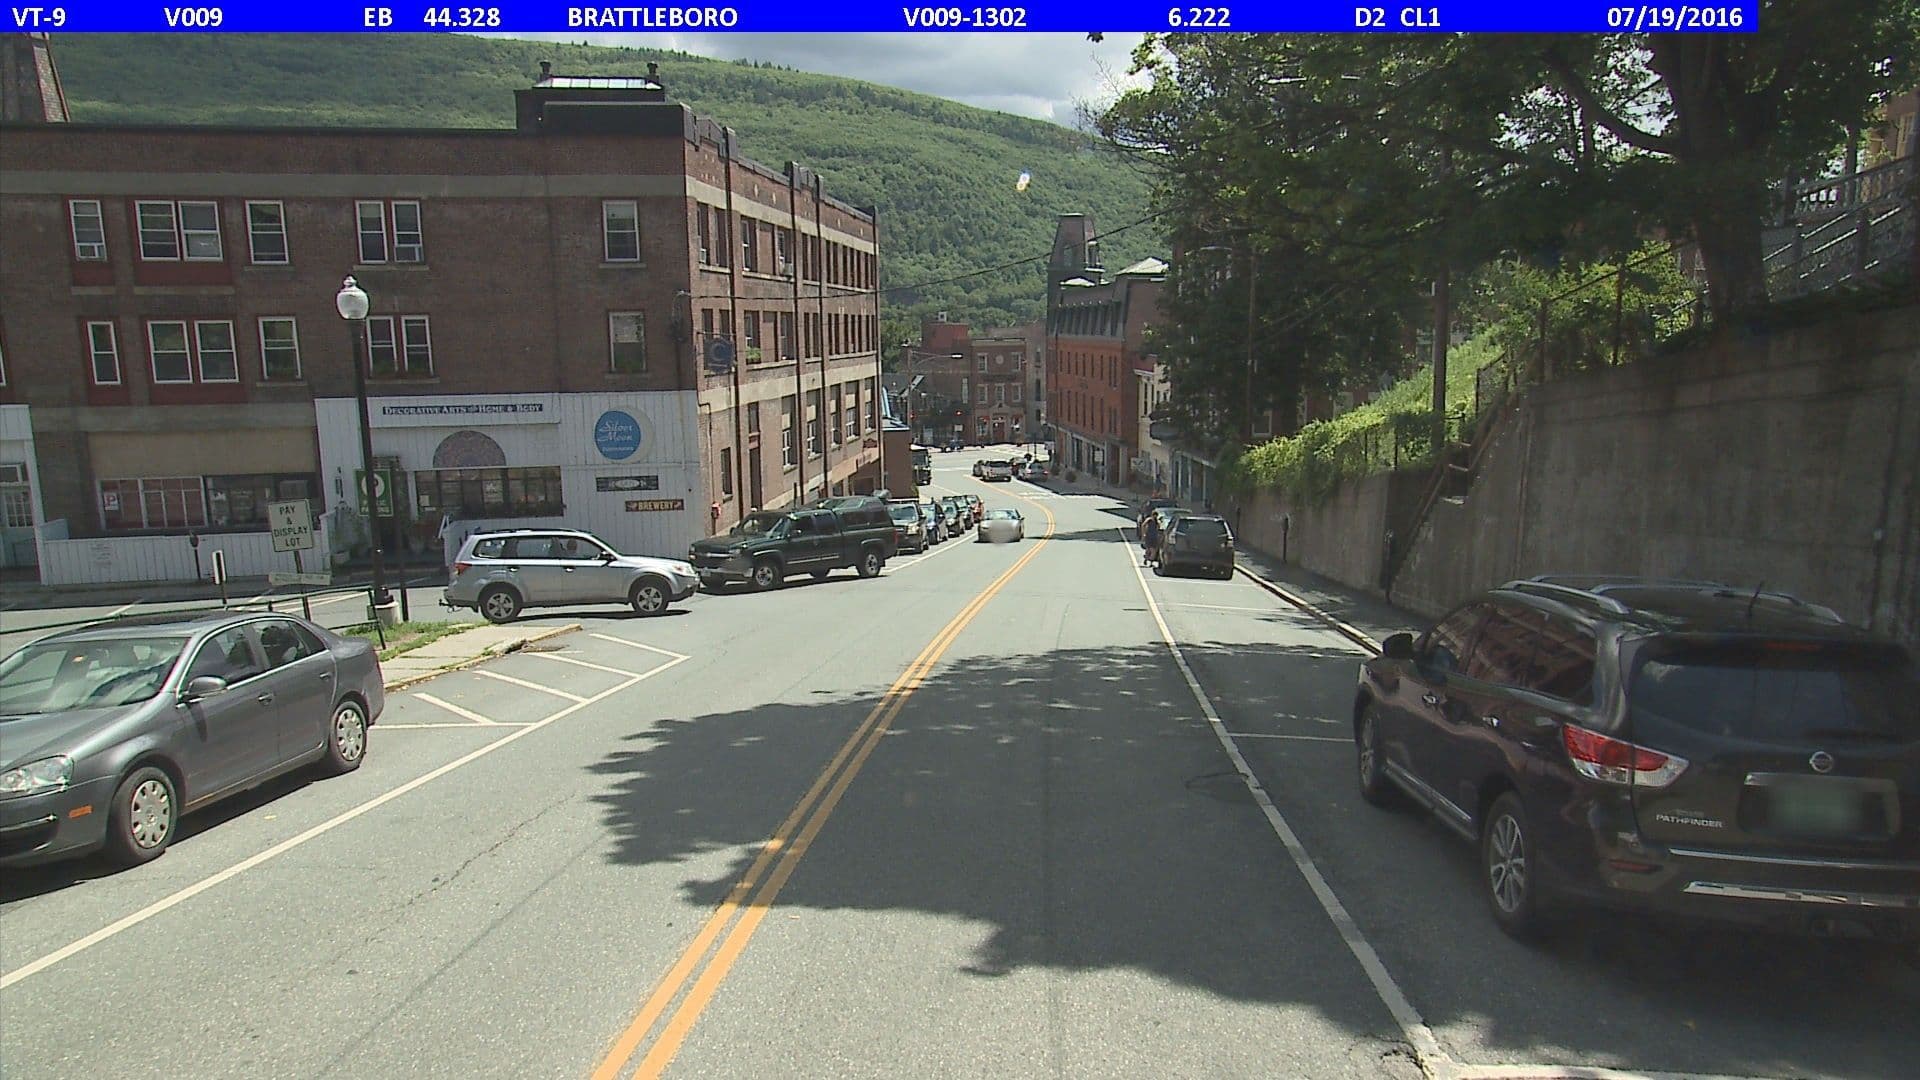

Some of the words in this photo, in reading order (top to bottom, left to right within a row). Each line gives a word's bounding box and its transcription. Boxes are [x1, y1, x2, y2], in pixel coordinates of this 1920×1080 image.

[279, 505, 296, 515] PAY
[638, 501, 674, 511] BREWERY
[274, 526, 308, 538] DISPLAY
[285, 537, 302, 547] LOT
[1656, 814, 1723, 827] PATHFINDER
